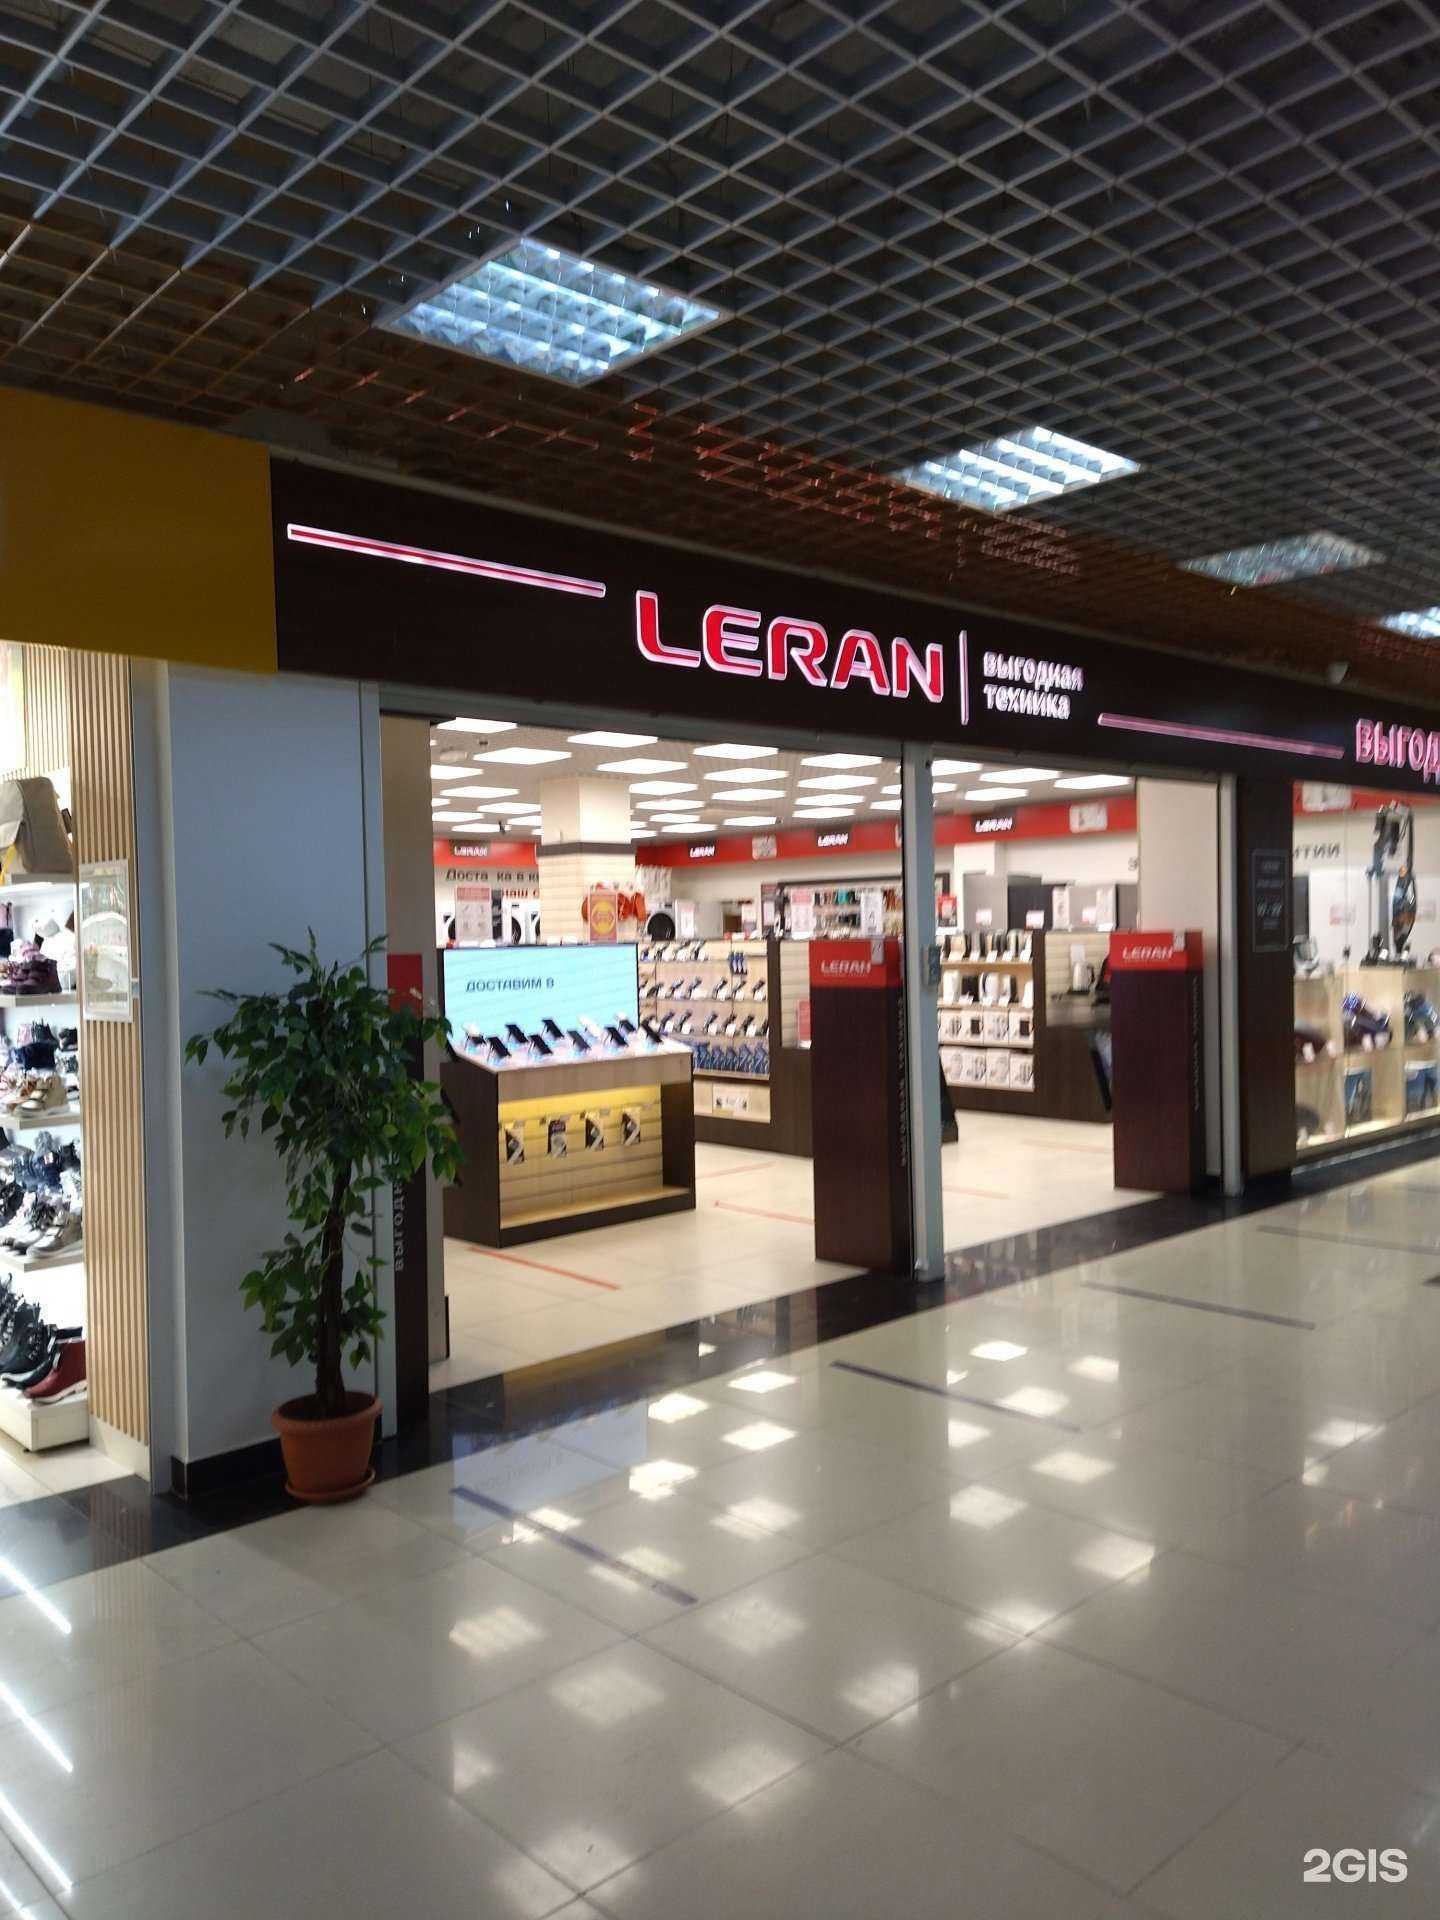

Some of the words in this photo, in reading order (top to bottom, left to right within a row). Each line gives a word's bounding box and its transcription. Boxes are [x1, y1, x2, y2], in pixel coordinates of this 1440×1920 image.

[636, 590, 943, 703] LERAN
[817, 832, 849, 847] LERAN
[1122, 946, 1174, 960] LERAN
[820, 960, 872, 975] LERAN
[466, 976, 542, 993] ДОСТАВИМ
